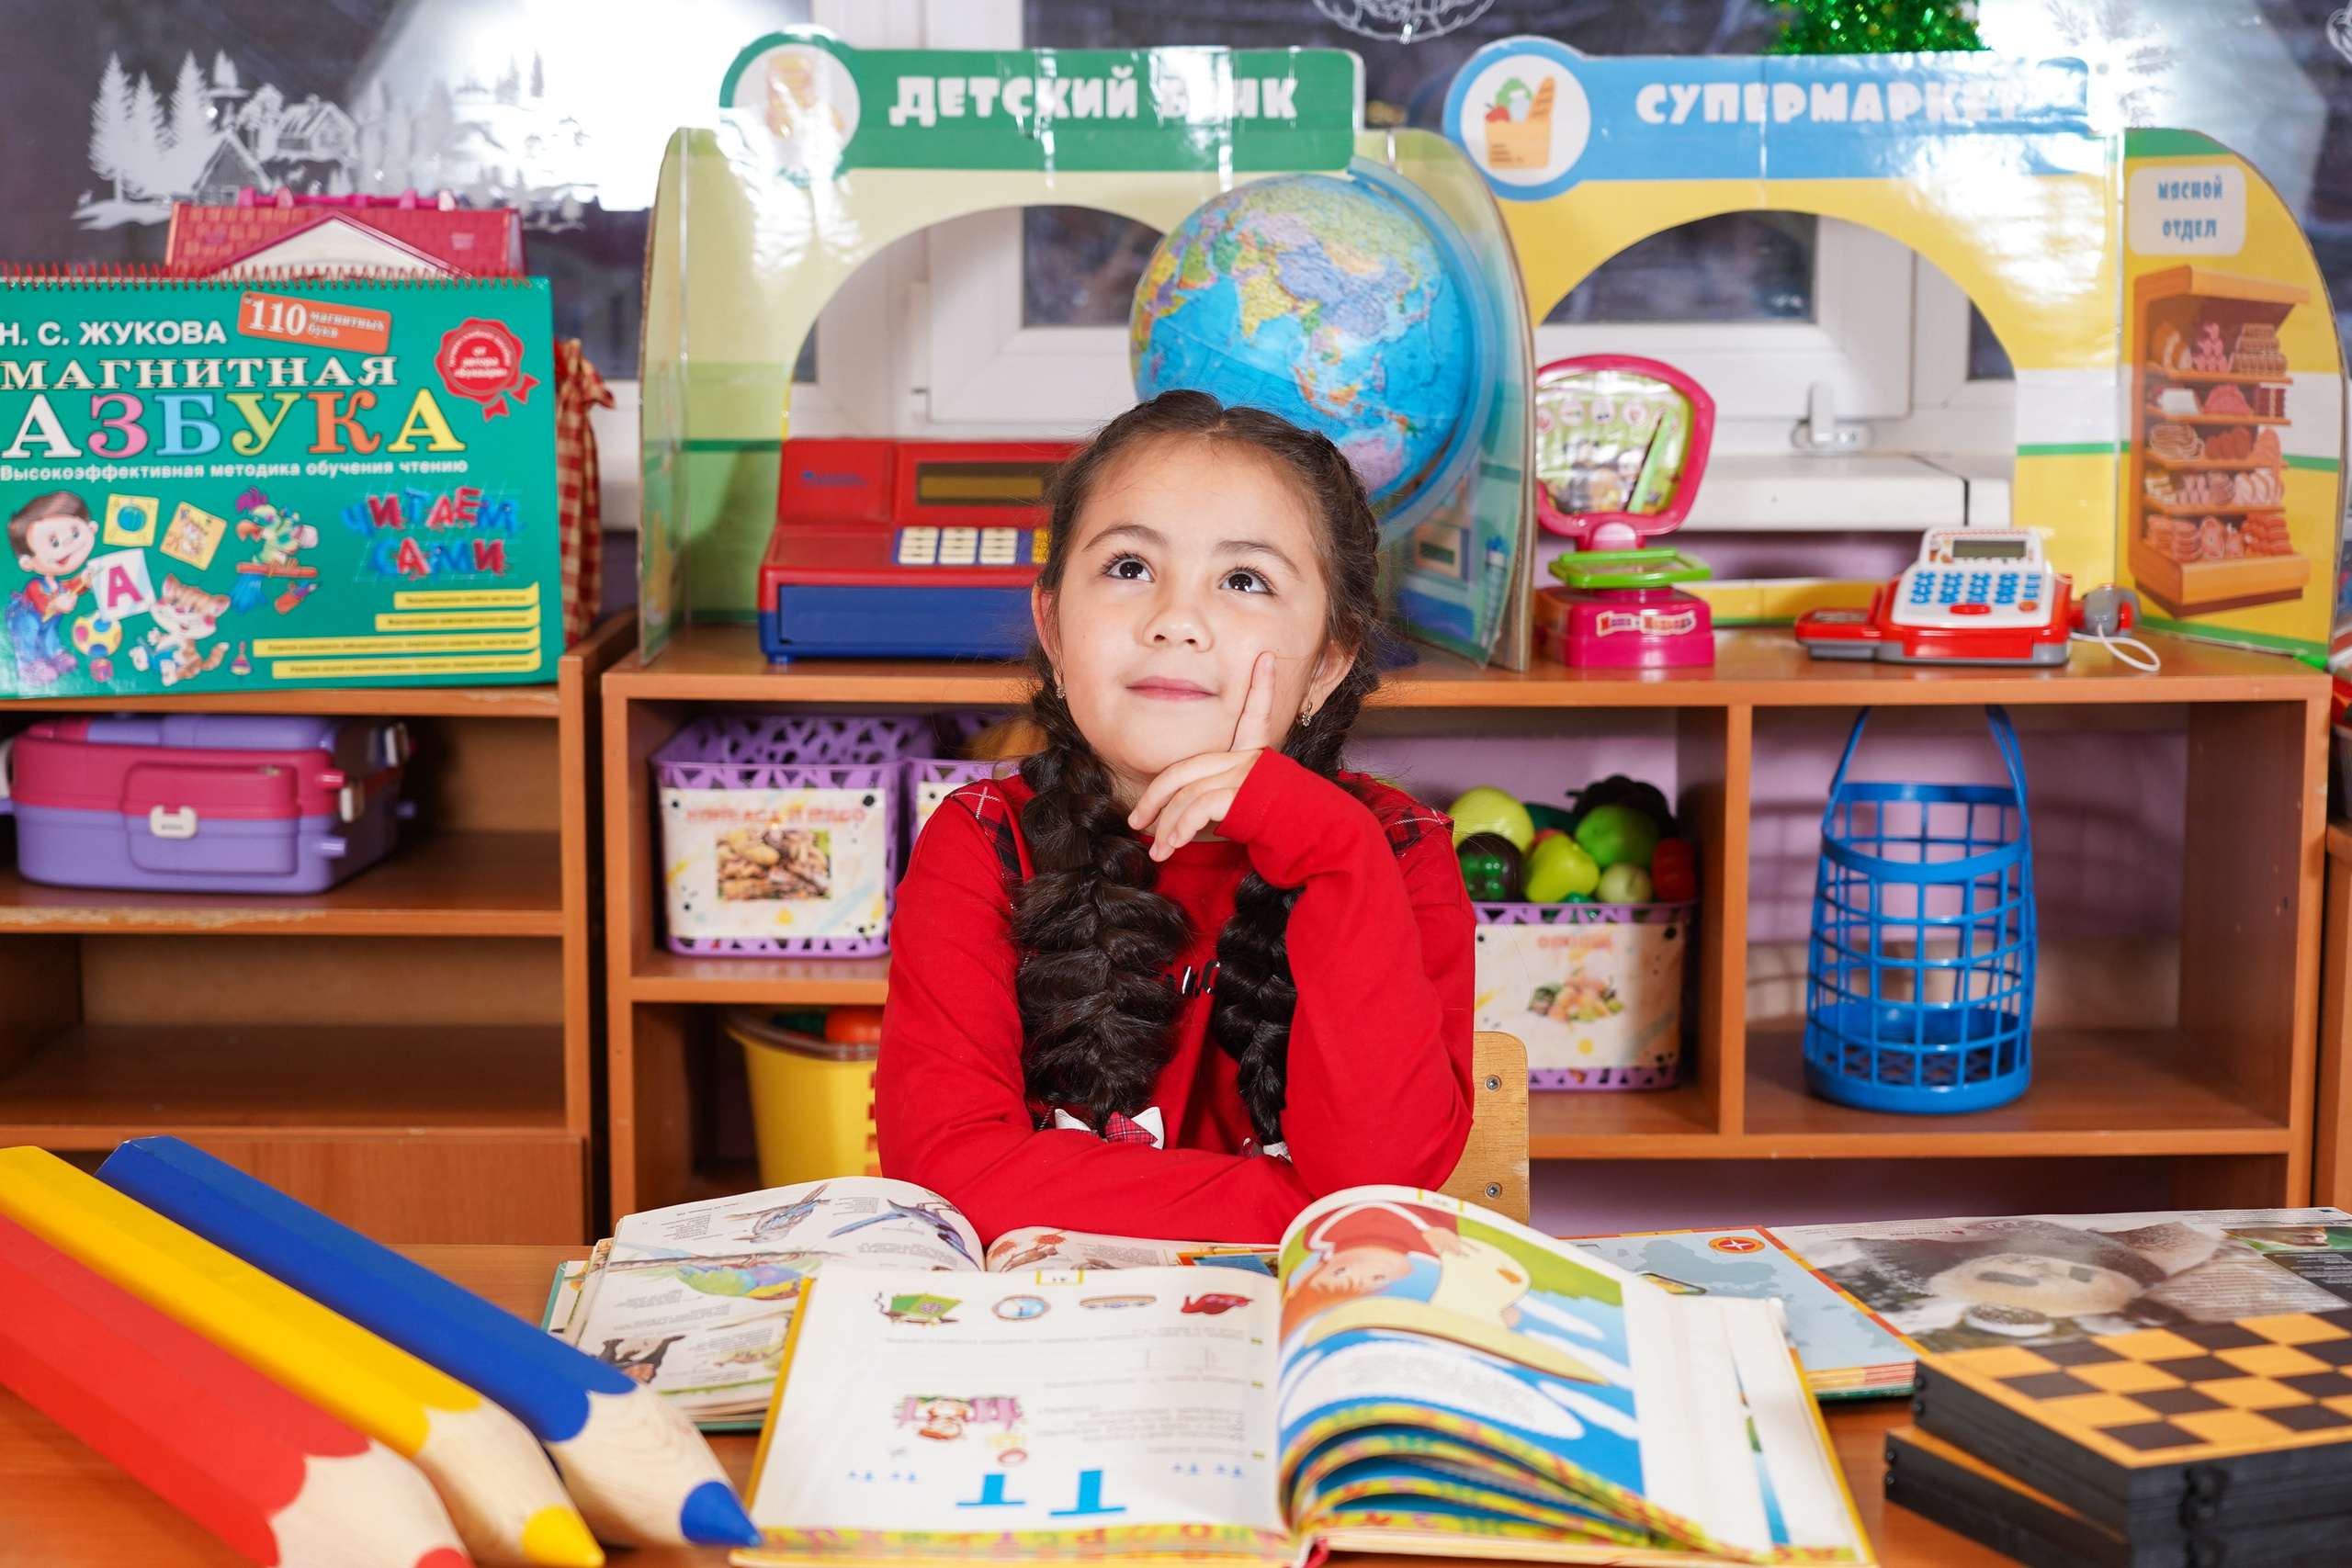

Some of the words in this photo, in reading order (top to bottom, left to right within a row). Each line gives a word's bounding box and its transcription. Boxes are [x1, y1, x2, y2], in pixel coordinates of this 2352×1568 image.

[889, 65, 1137, 127] ДЕТСКИЙ
[1159, 77, 1299, 119] БНК
[1635, 81, 2023, 125] СУПЕРМАРКЕТ
[2158, 175, 2223, 200] МЯСНОЙ
[2162, 219, 2217, 243] ОТДЕЛ
[38, 321, 70, 346] С.
[78, 321, 228, 345] ЖУКОВА
[248, 299, 307, 336] 110
[0, 355, 399, 390] МАГНИТНАЯ
[0, 388, 467, 458] АЗБУКА
[0, 463, 205, 483] Высокоэффективная
[210, 461, 301, 479] методика
[305, 459, 394, 479] обучения
[399, 459, 468, 474] чтению
[107, 564, 144, 609] А
